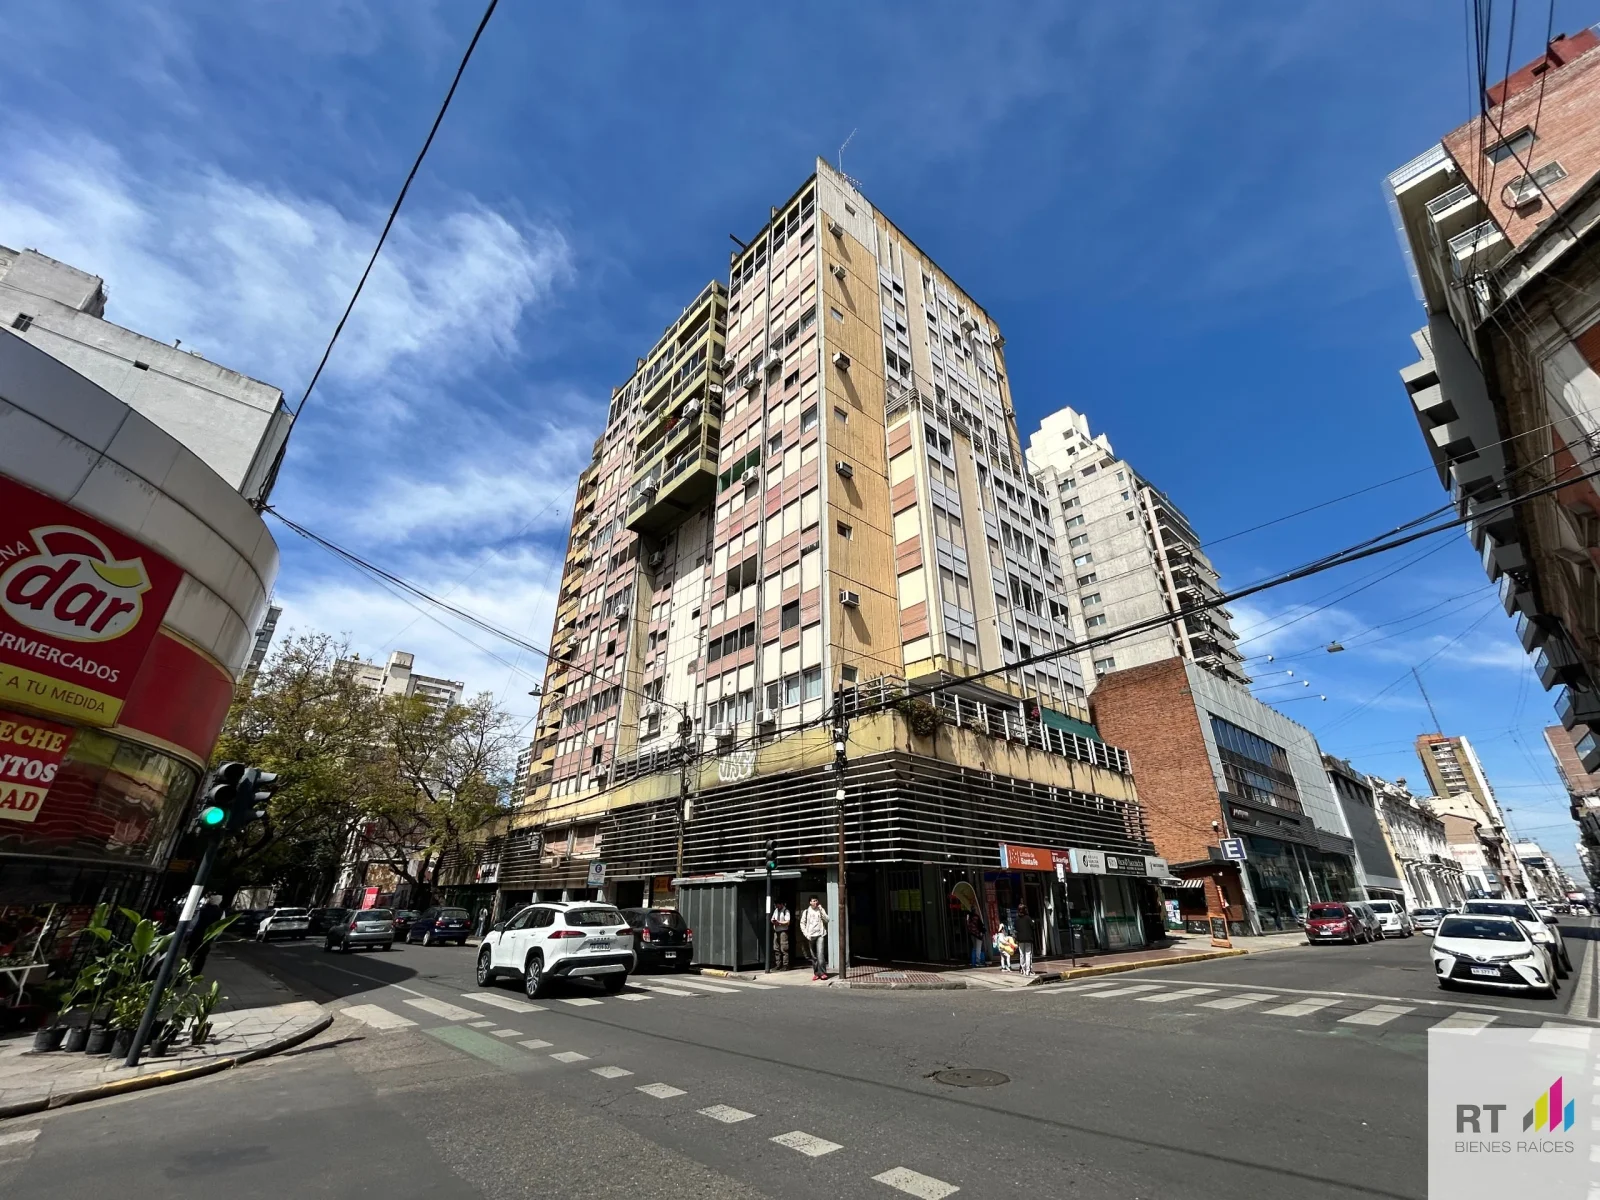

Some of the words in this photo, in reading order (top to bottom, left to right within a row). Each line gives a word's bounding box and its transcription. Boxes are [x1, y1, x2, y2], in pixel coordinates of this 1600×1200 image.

[0, 540, 31, 567] NA
[6, 559, 135, 633] dar
[0, 631, 120, 682] RMERCADOS
[6, 676, 19, 689] A
[27, 679, 47, 695] TU
[51, 686, 105, 713] MEDIDA
[0, 720, 67, 753] ECHE
[0, 788, 40, 812] AD
[1224, 841, 1241, 857] E
